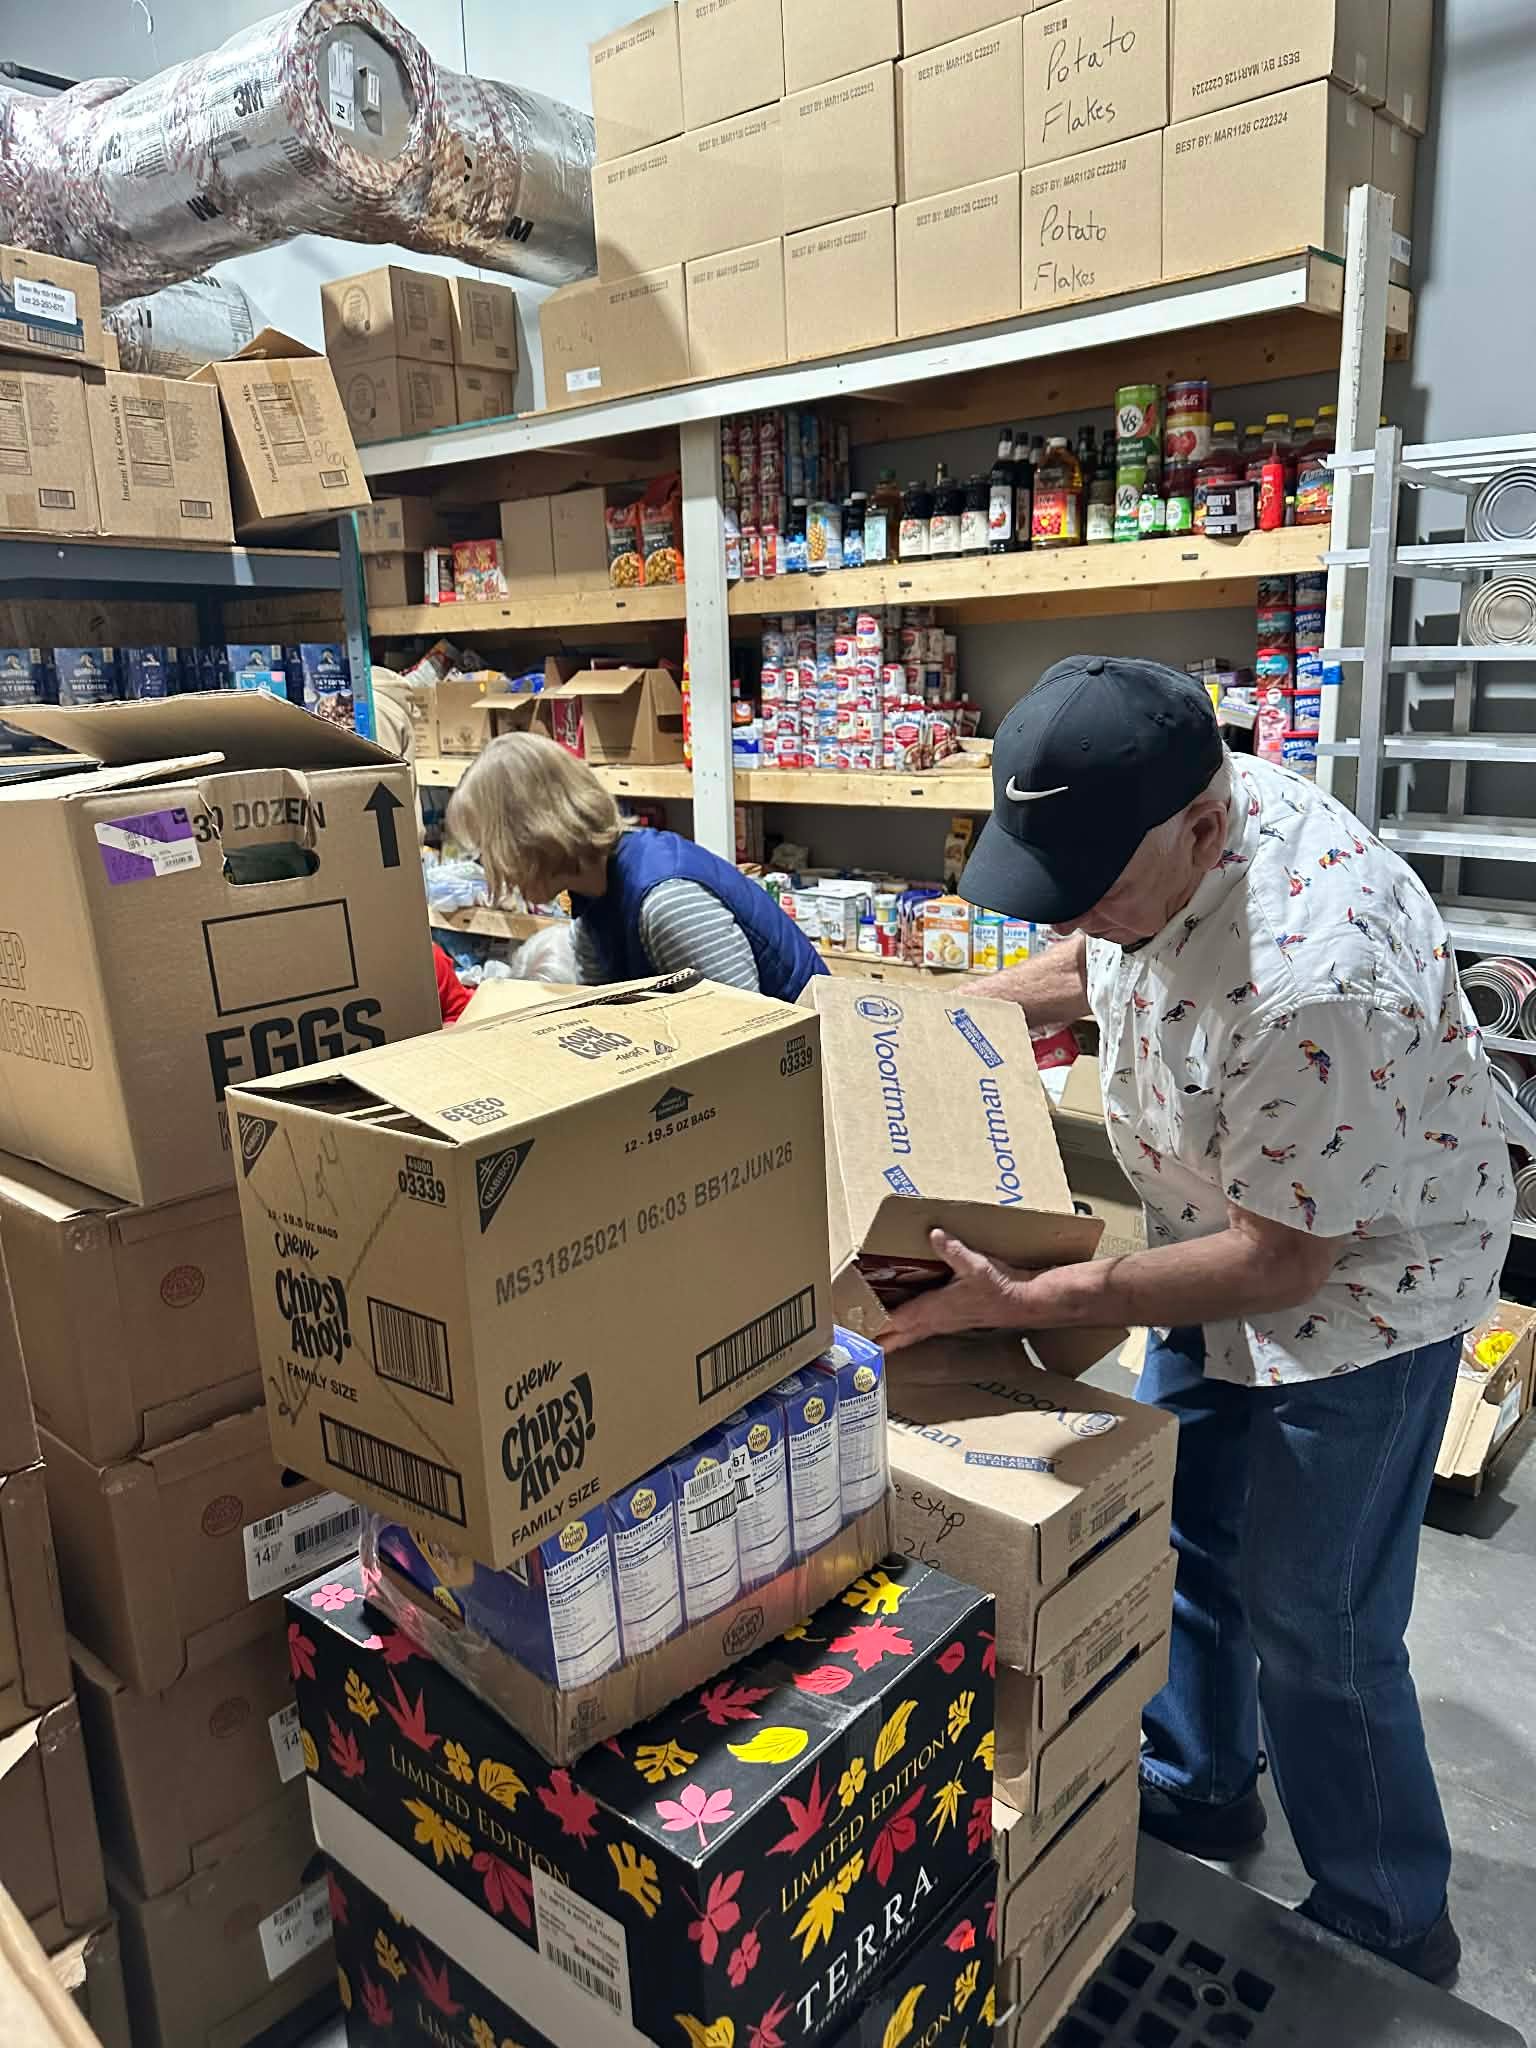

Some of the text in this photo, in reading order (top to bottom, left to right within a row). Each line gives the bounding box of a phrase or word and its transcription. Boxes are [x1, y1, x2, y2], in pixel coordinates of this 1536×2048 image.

[1047, 16, 1136, 91] Potato
[1262, 57, 1276, 73] BY:
[1278, 51, 1301, 68] BEST
[918, 66, 934, 81] BEST
[233, 79, 265, 118] 3M
[1042, 95, 1115, 143] Flakes
[1175, 140, 1196, 155] BEST
[1198, 133, 1213, 150] BY:
[1030, 182, 1049, 197] BEST
[1050, 176, 1062, 192] BY:
[1041, 204, 1107, 246] Potato
[1033, 262, 1096, 293] Flakes
[1120, 409, 1137, 432] V8
[193, 797, 326, 843] 30 DOZEN
[206, 998, 387, 1103] EGGS
[582, 1032, 633, 1055] Chips
[779, 1047, 813, 1077] 03339
[872, 1029, 912, 1155] Voortman
[441, 1097, 505, 1121] 03339
[624, 1139, 638, 1153] 12
[647, 1121, 674, 1146] 19.5
[676, 1117, 689, 1133] OZ
[690, 1107, 717, 1127] BAGS
[979, 1077, 1024, 1206] Voortman
[398, 1168, 446, 1204] 03339
[495, 1217, 628, 1306] MS31825021
[637, 1191, 687, 1235] 06:03
[275, 1268, 336, 1321] Chips
[286, 1362, 359, 1403] FAMILY SIZE
[840, 1395, 870, 1408] Nutrition
[501, 1388, 578, 1483] Chips
[791, 1426, 822, 1442] Nutrition
[511, 1476, 602, 1548] FAMILY SIZE
[632, 1493, 654, 1510] Honey
[561, 1525, 585, 1541] Honey
[616, 1517, 653, 1541] Nutrition
[255, 1547, 271, 1568] 14
[546, 1552, 584, 1578] Nutrition
[283, 1729, 299, 1751] 14
[390, 1744, 570, 1888] LIMITED EDITION
[781, 1729, 946, 1913] LIMITED EDITION
[796, 1865, 934, 2035] TERRA
